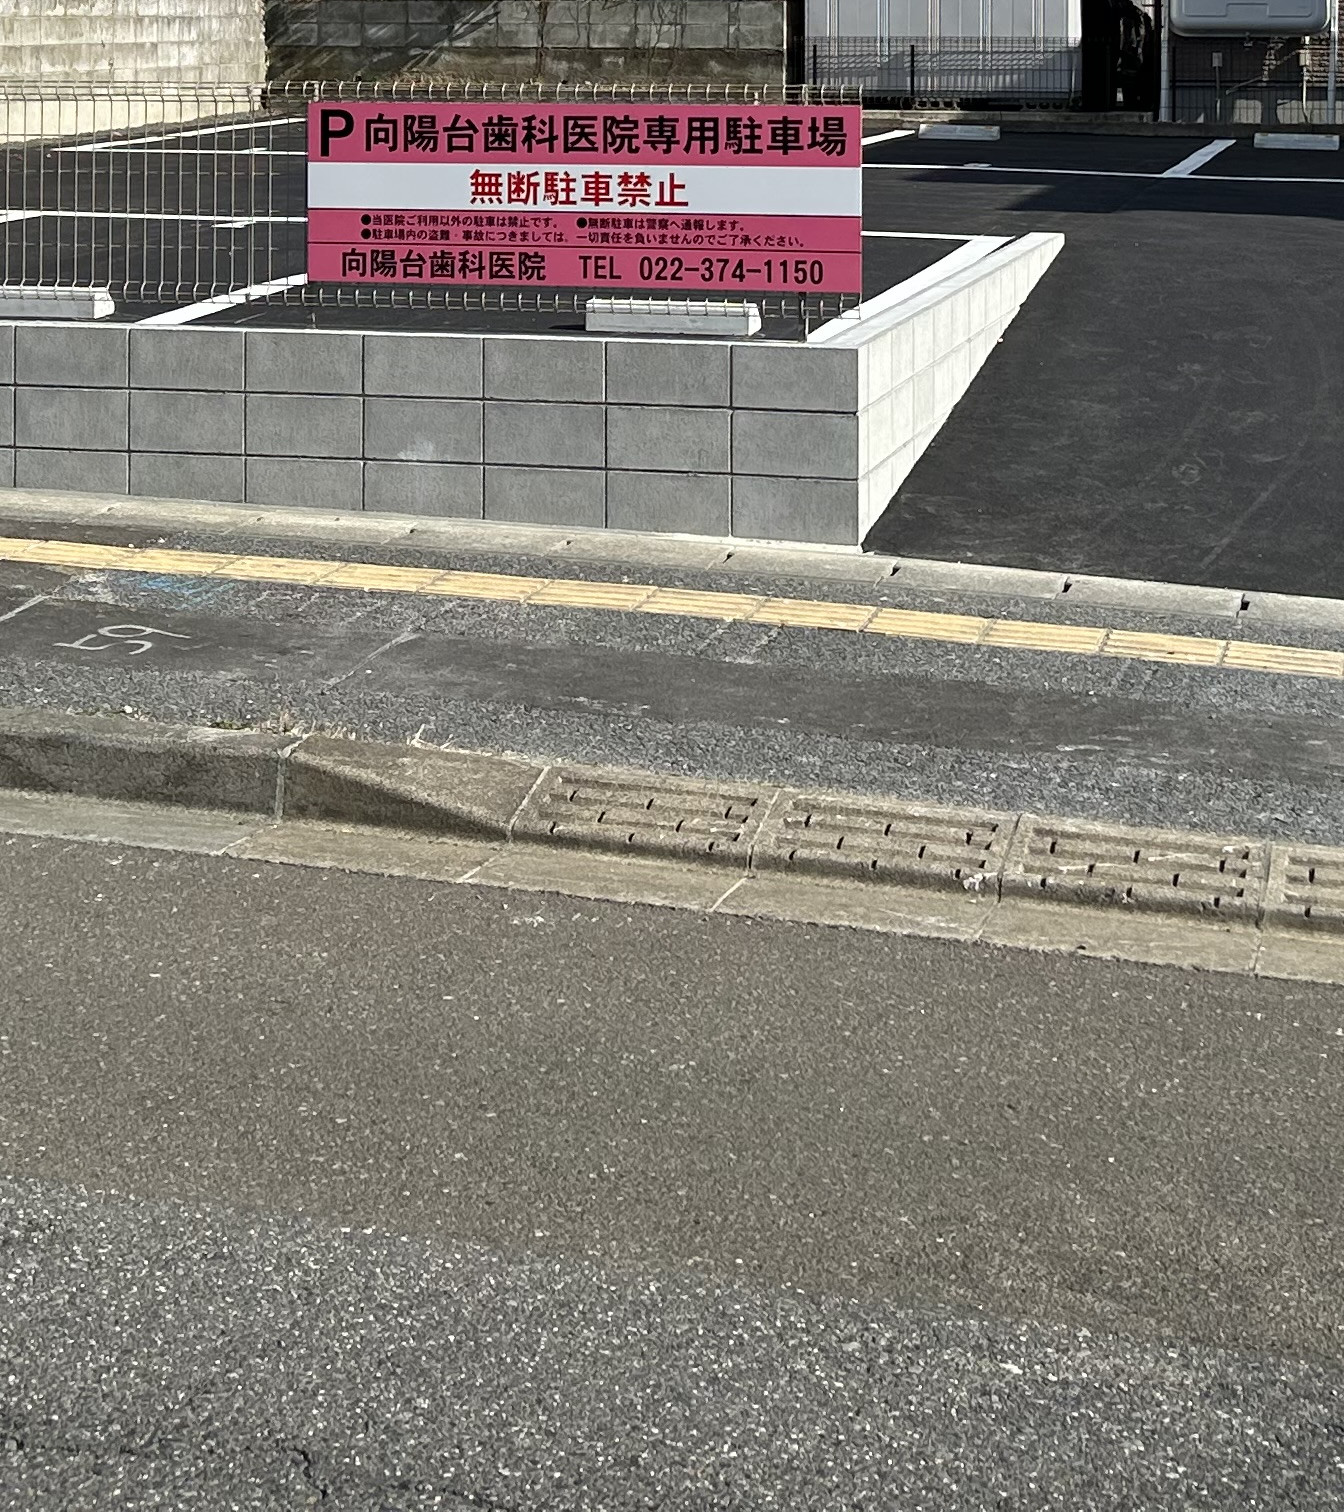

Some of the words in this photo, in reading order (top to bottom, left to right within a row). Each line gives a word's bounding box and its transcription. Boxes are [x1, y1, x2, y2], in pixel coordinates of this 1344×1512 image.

[320, 109, 354, 156] P
[364, 113, 848, 157] 向陽台歯科医院専用駐車場
[469, 169, 689, 207] 無断駐車禁止
[341, 248, 547, 281] 向陽台歯科医院
[579, 255, 621, 280] TEL
[639, 256, 824, 285] 022-374-1150
